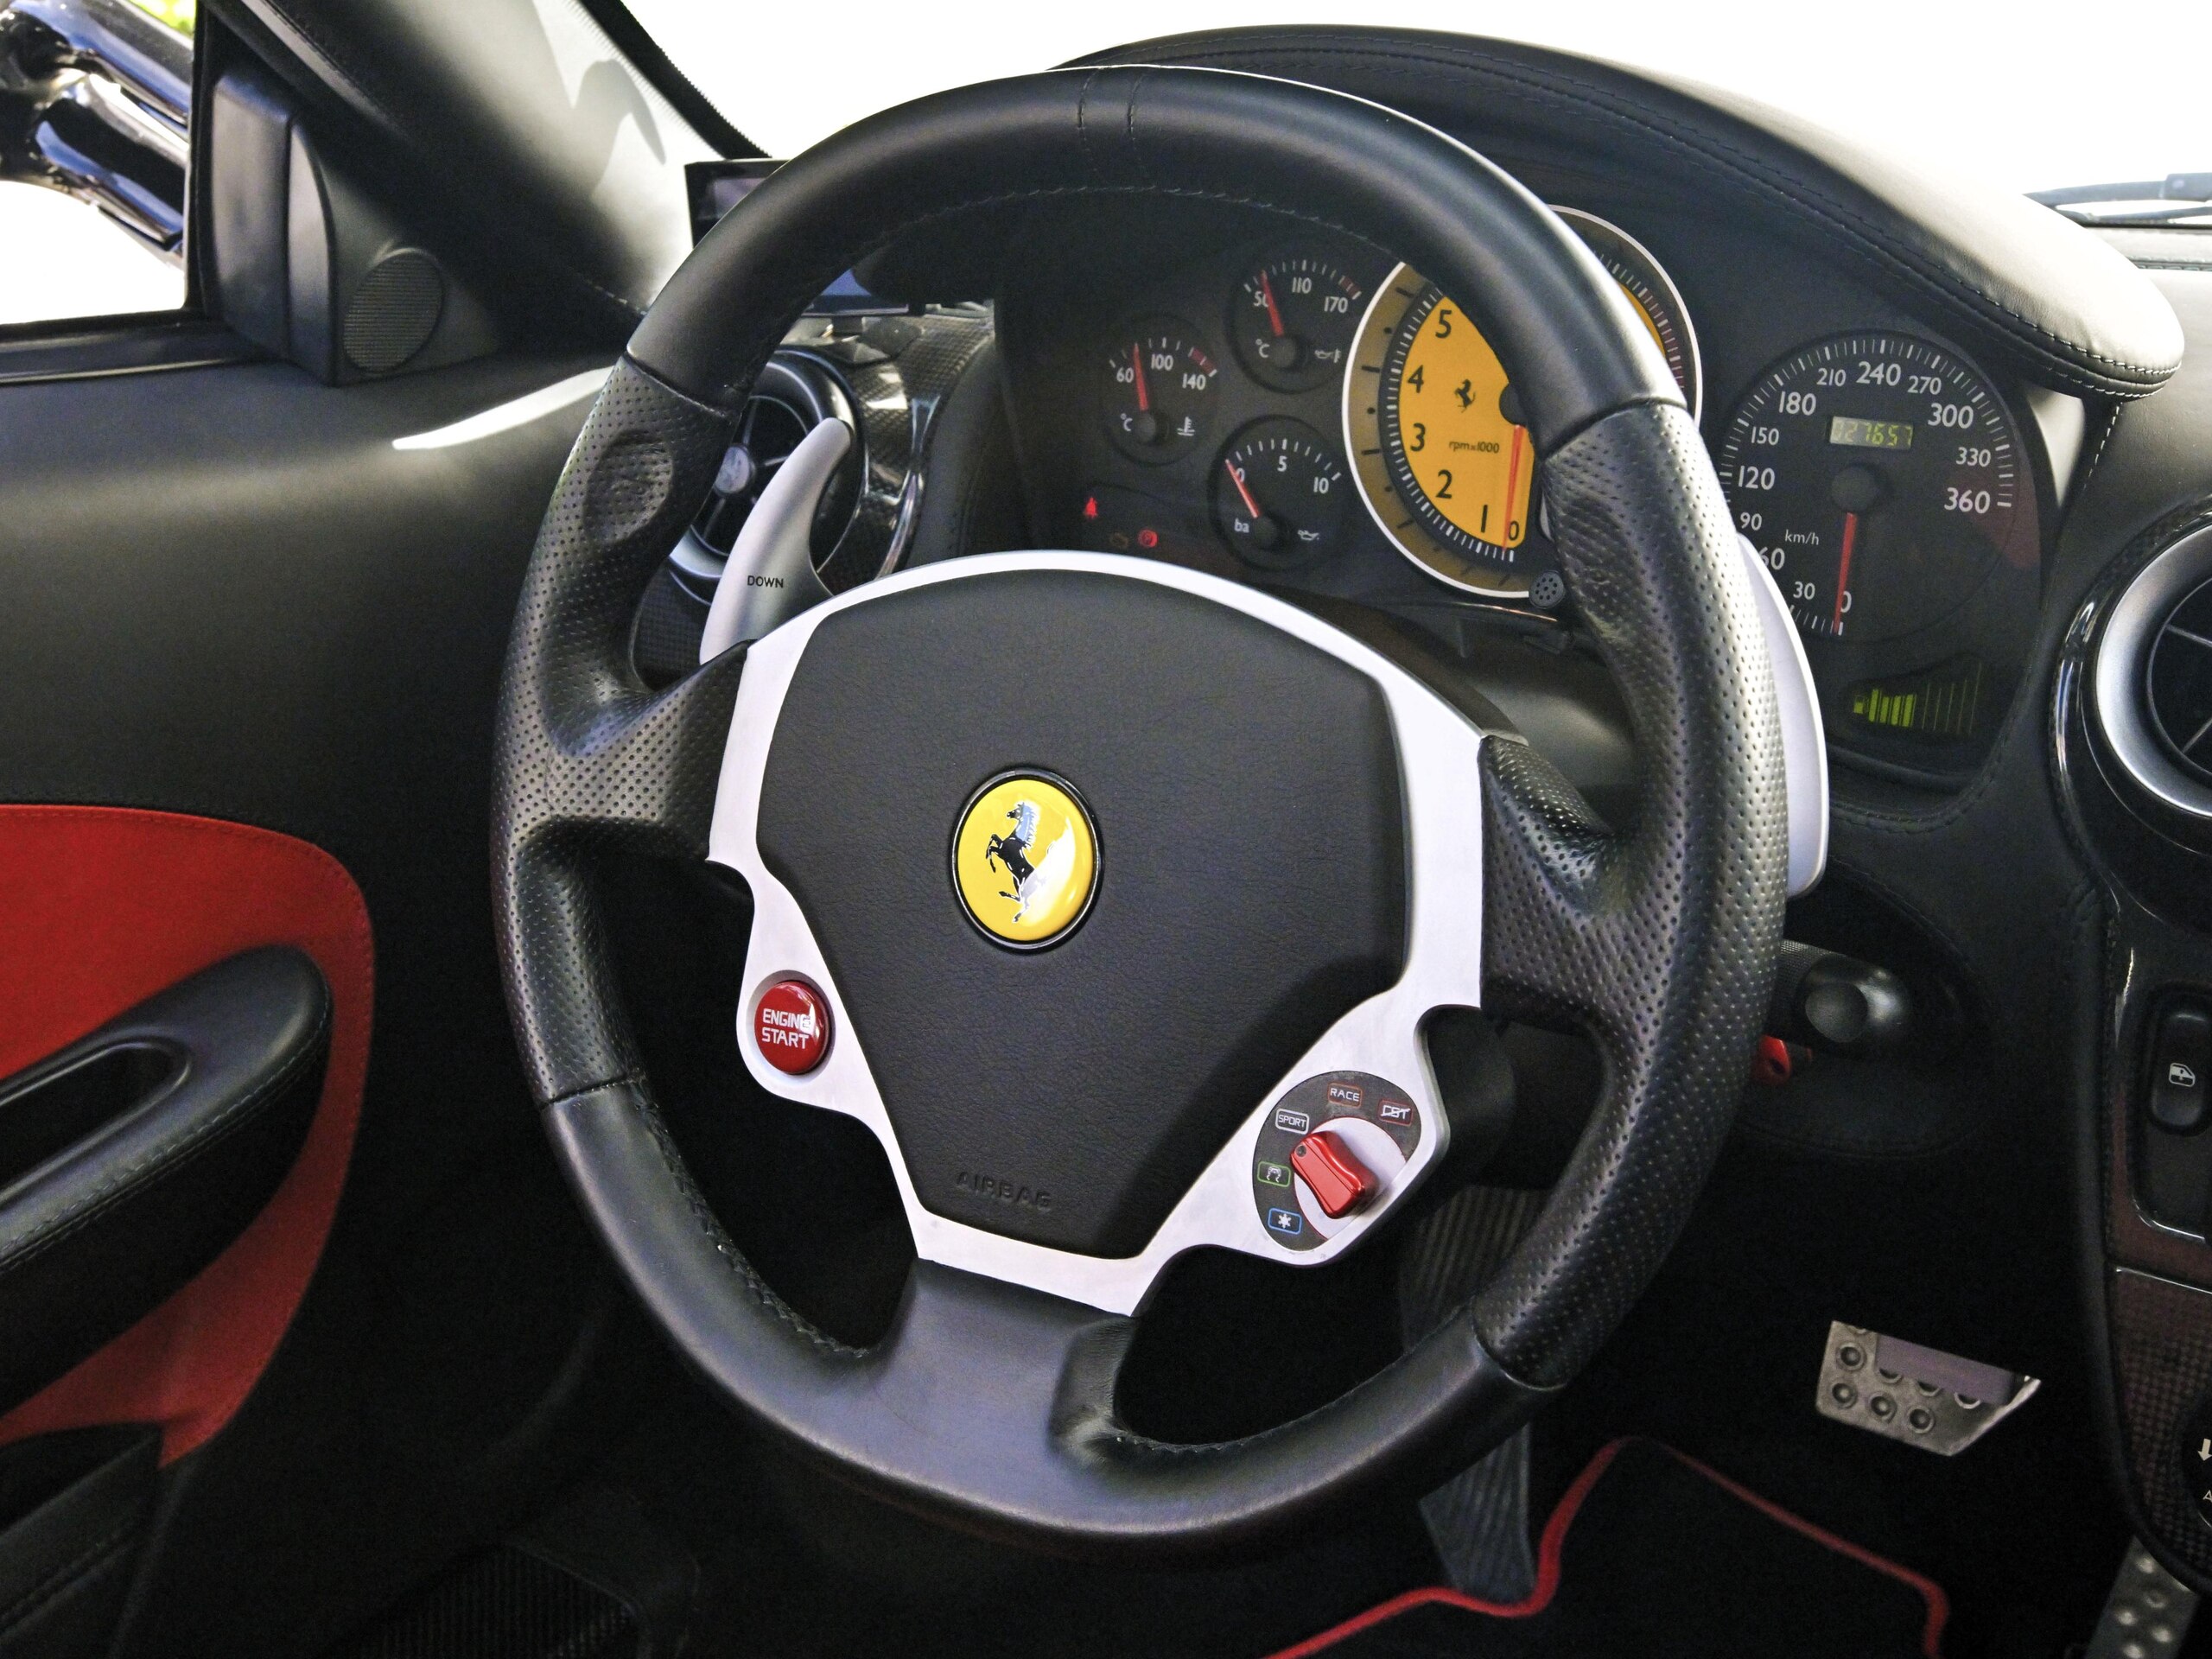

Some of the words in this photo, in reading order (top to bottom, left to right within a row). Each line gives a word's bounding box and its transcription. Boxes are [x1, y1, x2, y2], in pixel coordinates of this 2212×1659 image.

[1292, 276, 1312, 294] 110
[1324, 296, 1348, 313] 170
[1434, 309, 1452, 339] 5
[1151, 353, 1173, 371] 100
[1116, 367, 1134, 383] 60
[1182, 373, 1206, 391] 140
[1408, 365, 1424, 393] 4
[1816, 368, 1847, 387] 210
[1856, 361, 1902, 387] 240
[1907, 375, 1942, 396] 270
[1778, 391, 1816, 416] 180
[1928, 403, 1974, 429] 300
[1409, 423, 1427, 452] 3
[1751, 427, 1779, 446] 150
[1278, 455, 1287, 473] 5
[1955, 447, 1991, 467] 330
[1313, 477, 1329, 494] 10
[1435, 469, 1452, 499] 2
[1738, 465, 1776, 490] 120
[1944, 488, 1991, 514] 360
[1480, 504, 1488, 533] 1
[1739, 513, 1763, 531] 90
[1509, 520, 1519, 541] 0
[1784, 529, 1820, 546] km/h
[747, 575, 784, 588] DOWN
[1793, 581, 1815, 601] 30
[762, 1008, 811, 1029] ENGINE
[761, 1027, 810, 1050] START
[1330, 1088, 1360, 1102] RACE
[1277, 1114, 1307, 1128] SPORT
[957, 1171, 1052, 1211] AIRBAG
